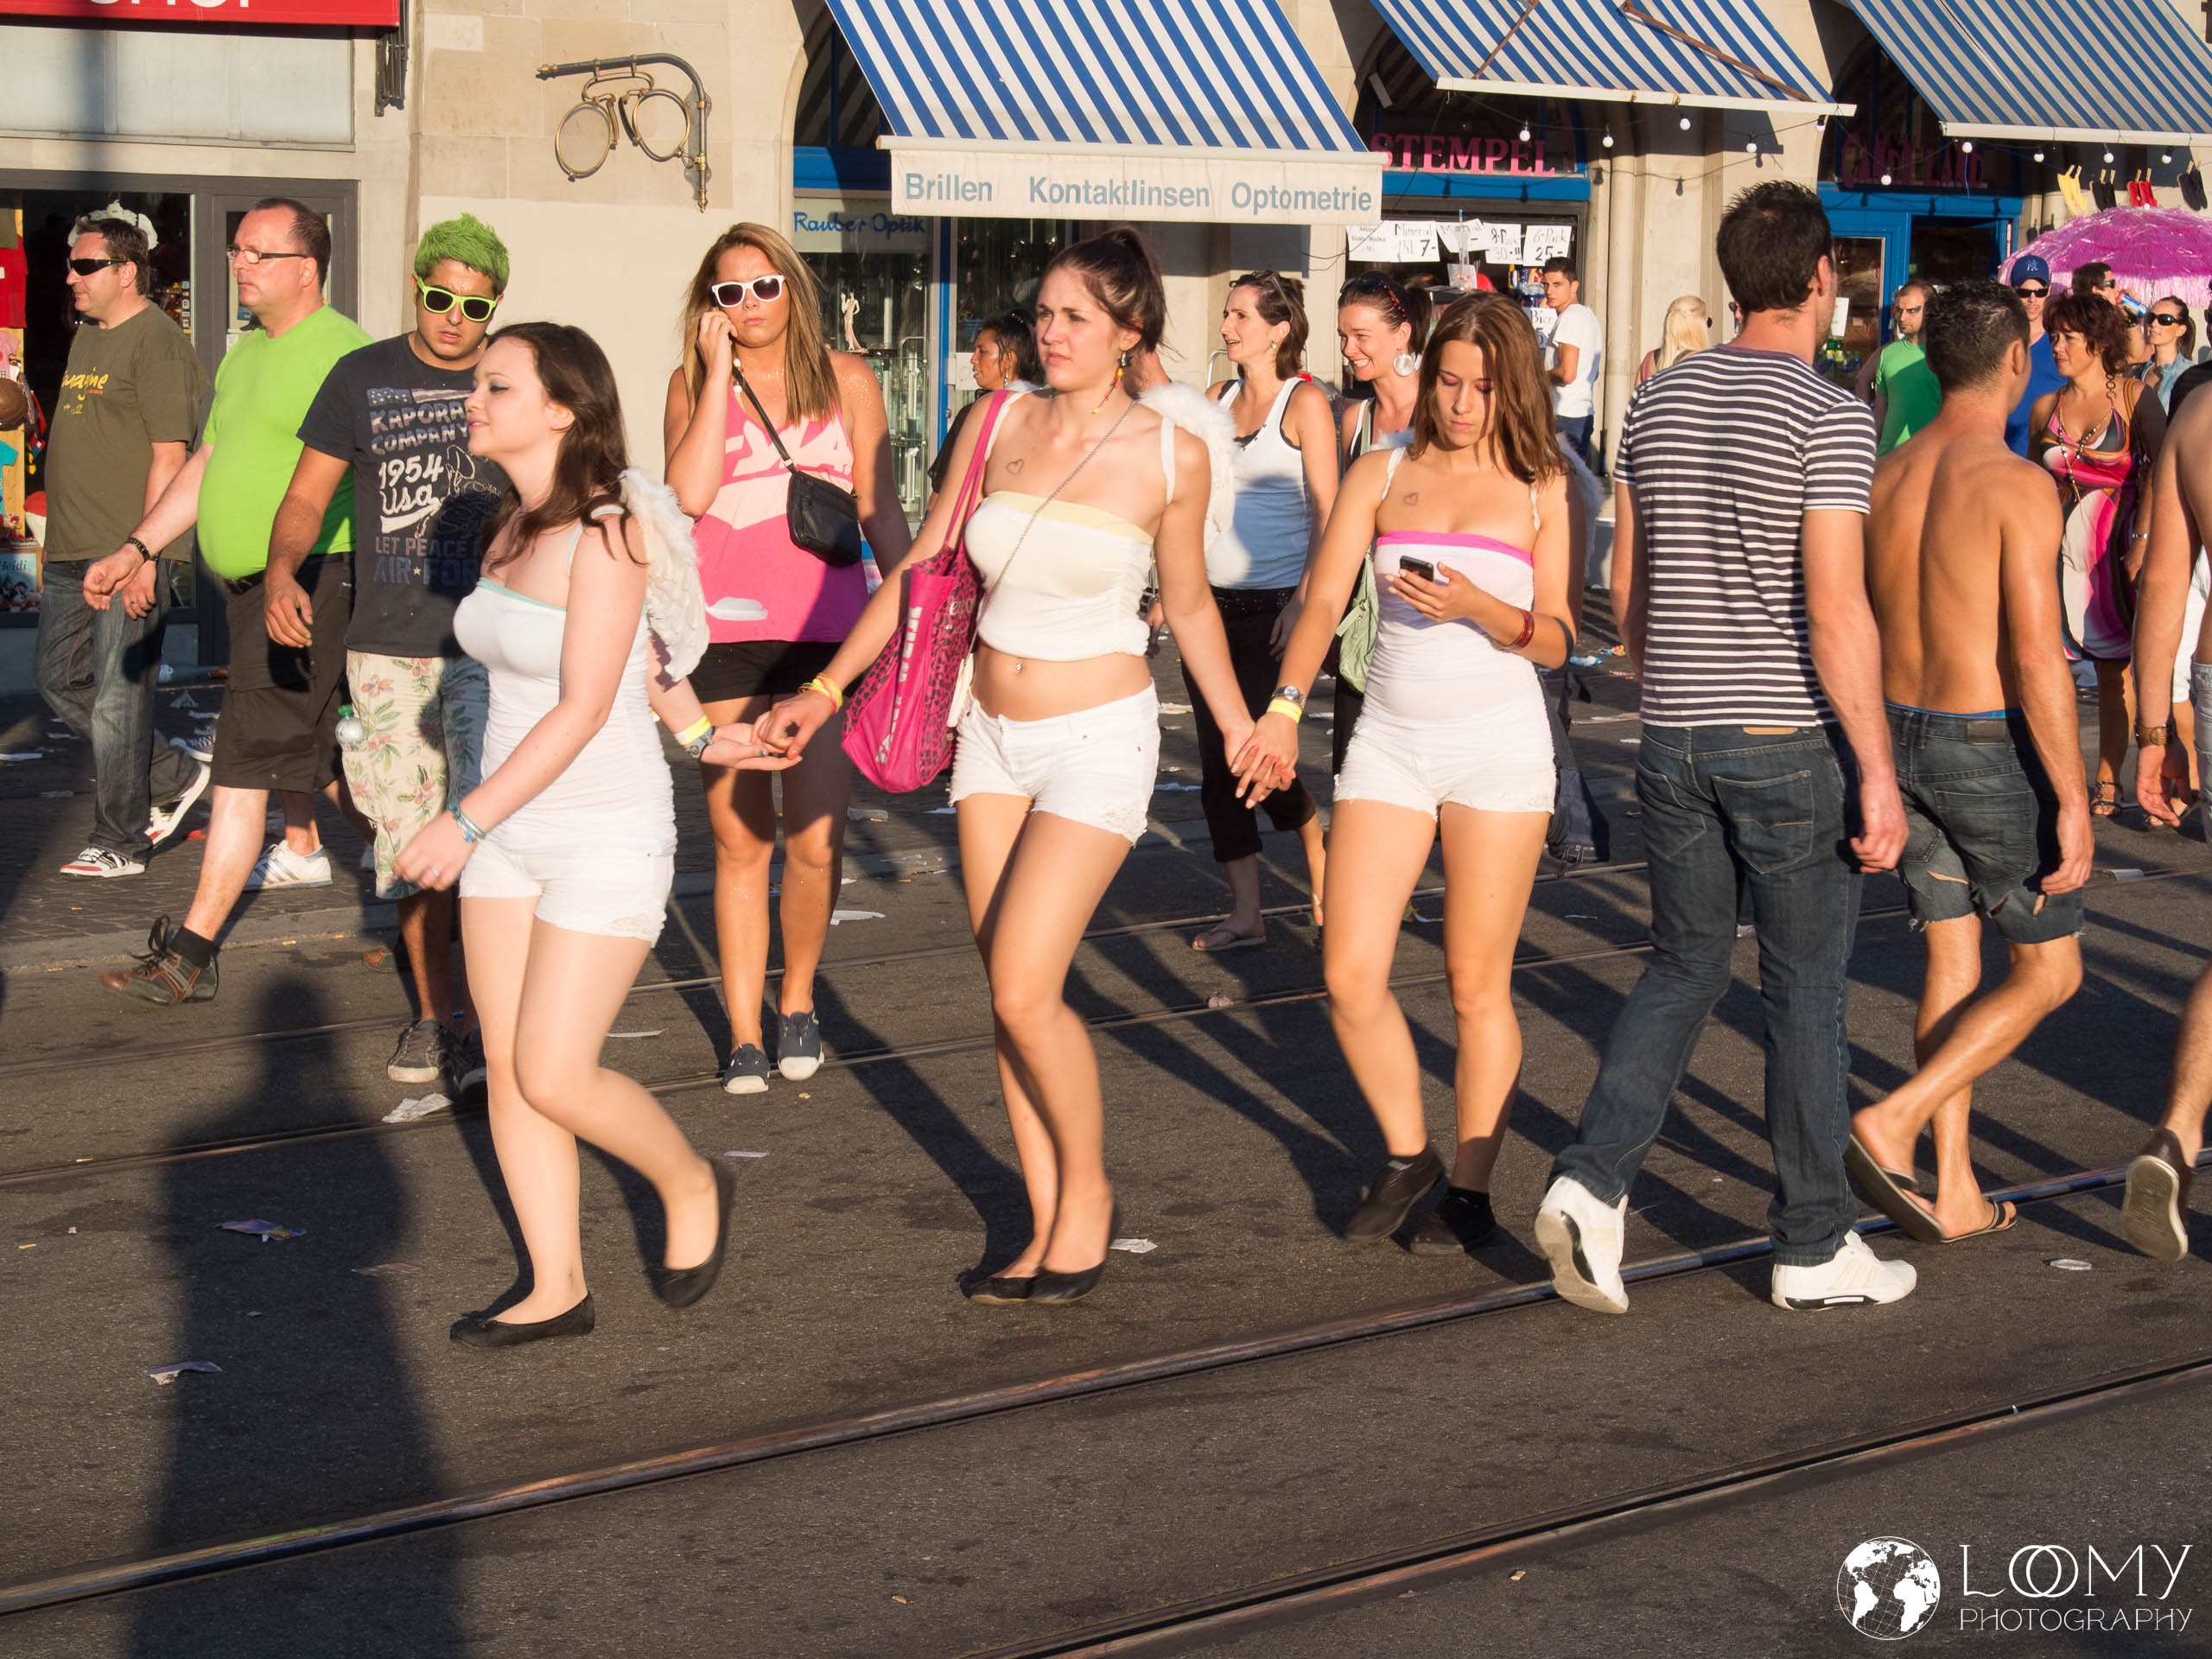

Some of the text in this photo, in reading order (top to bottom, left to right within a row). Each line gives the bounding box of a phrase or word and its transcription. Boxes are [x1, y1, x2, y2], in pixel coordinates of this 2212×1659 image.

[1370, 132, 1555, 176] STEMPEL
[906, 173, 1372, 215] Brillen Kontaktlinsen Optometrie
[794, 212, 926, 239] Rauber Optik
[371, 423, 467, 455] COMPANY
[378, 454, 444, 489] 1954
[375, 536, 400, 555] LET
[405, 537, 465, 557] PEACE
[372, 556, 411, 585] AIR
